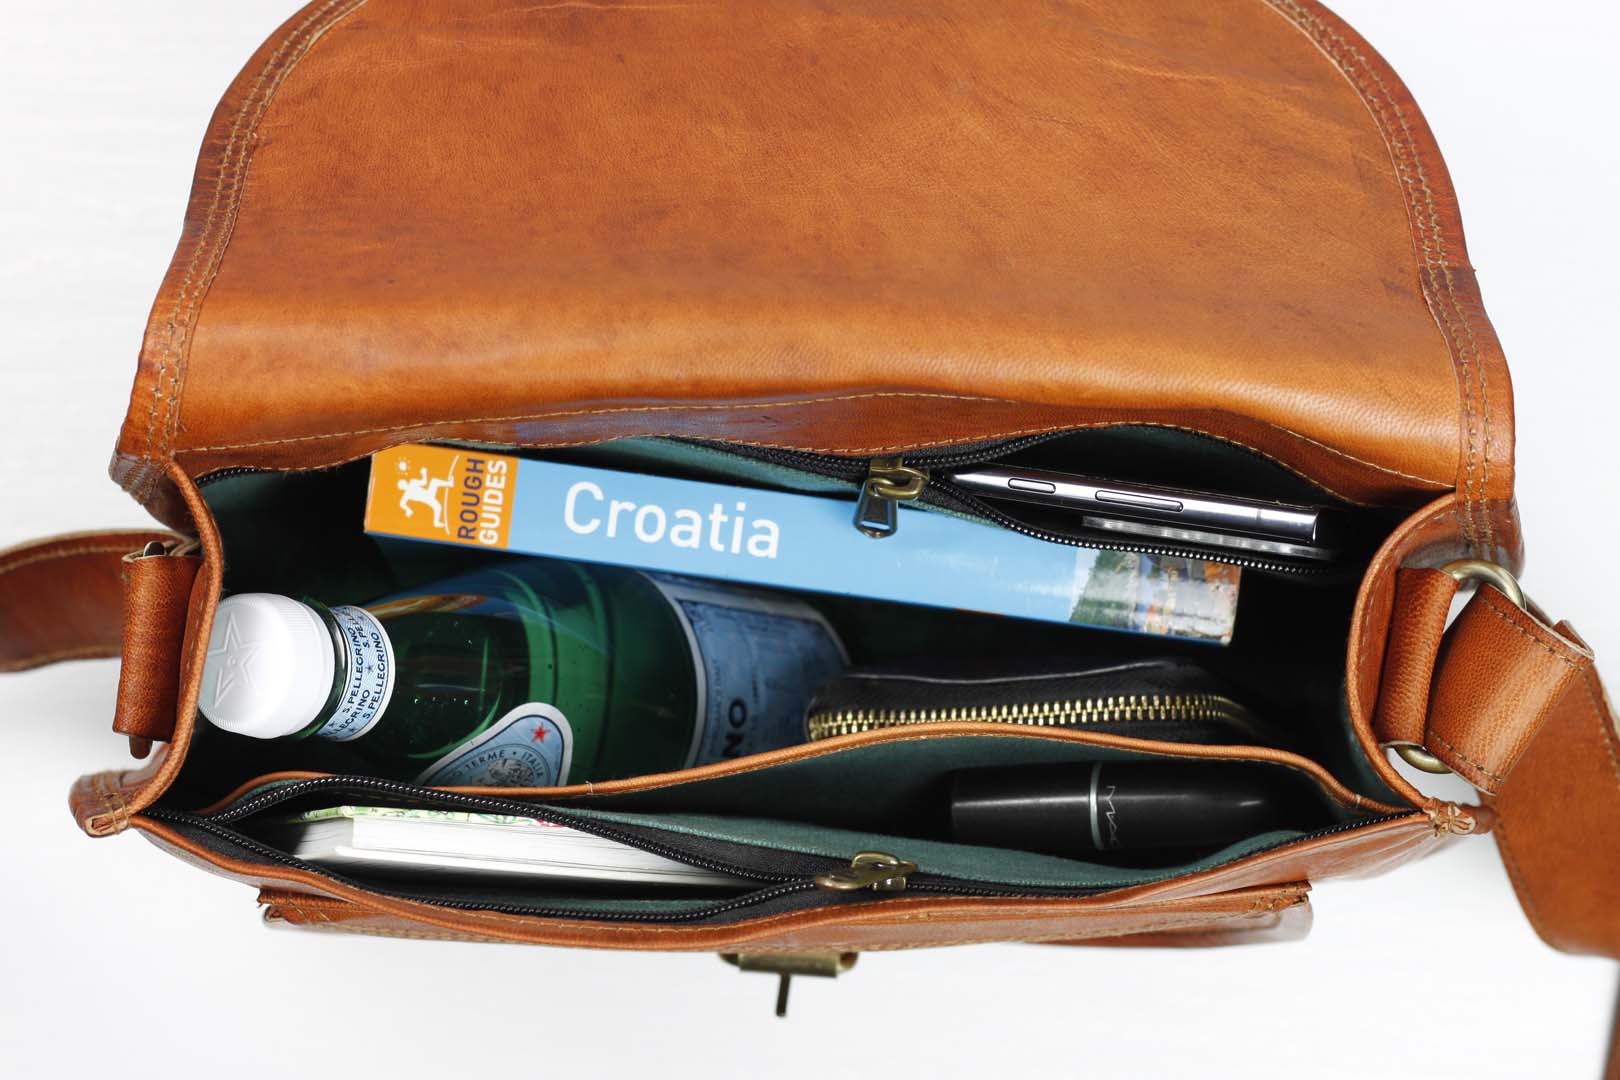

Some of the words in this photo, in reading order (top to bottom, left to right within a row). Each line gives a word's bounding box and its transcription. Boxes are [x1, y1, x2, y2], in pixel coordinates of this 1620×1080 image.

[457, 458, 485, 540] ROUGH
[479, 459, 508, 545] GUIDES
[563, 481, 780, 559] Croatia
[346, 627, 364, 705] PELLEGRINO
[367, 632, 386, 710] PELLEGRINO
[465, 749, 505, 770] TERME
[520, 751, 545, 777] ITALIA
